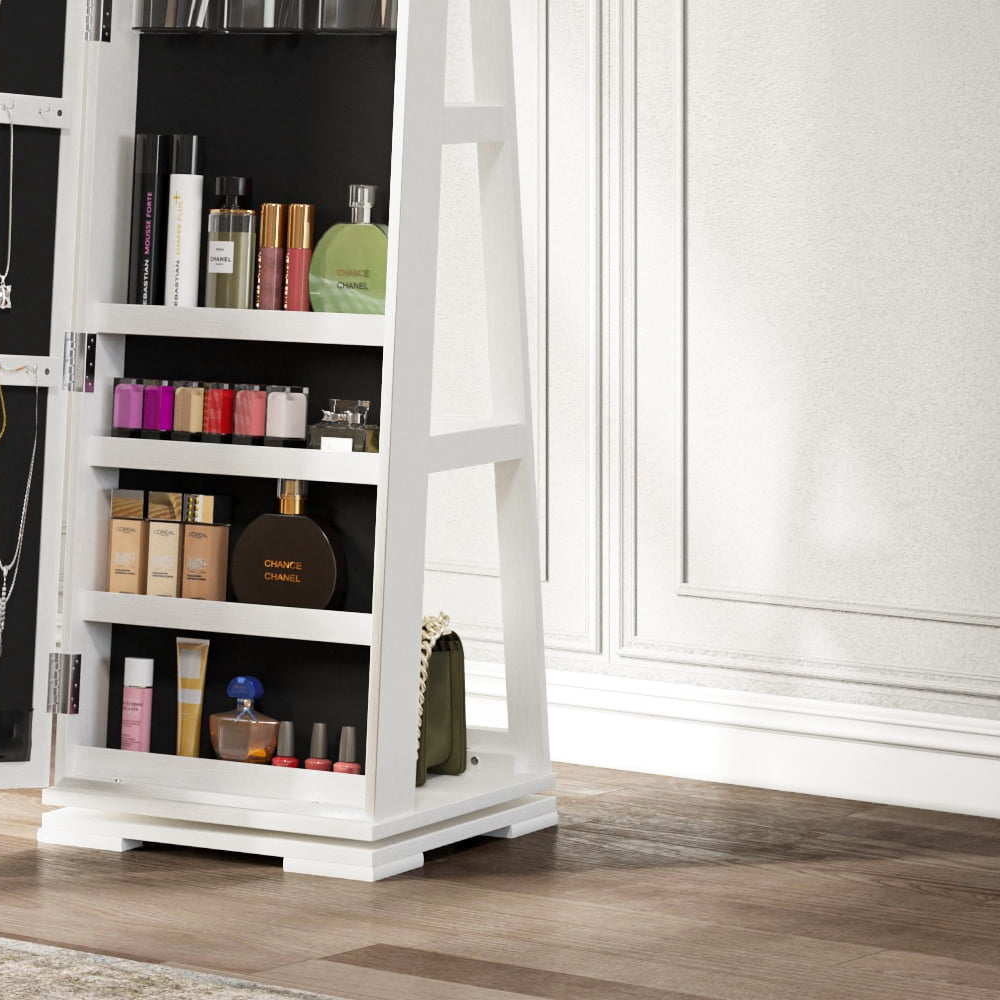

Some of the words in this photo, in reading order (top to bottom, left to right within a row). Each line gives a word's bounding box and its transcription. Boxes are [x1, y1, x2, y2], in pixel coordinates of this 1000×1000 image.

[336, 281, 369, 290] CHANEL
[264, 559, 303, 570] CHANCE
[264, 572, 301, 583] CHANEL
